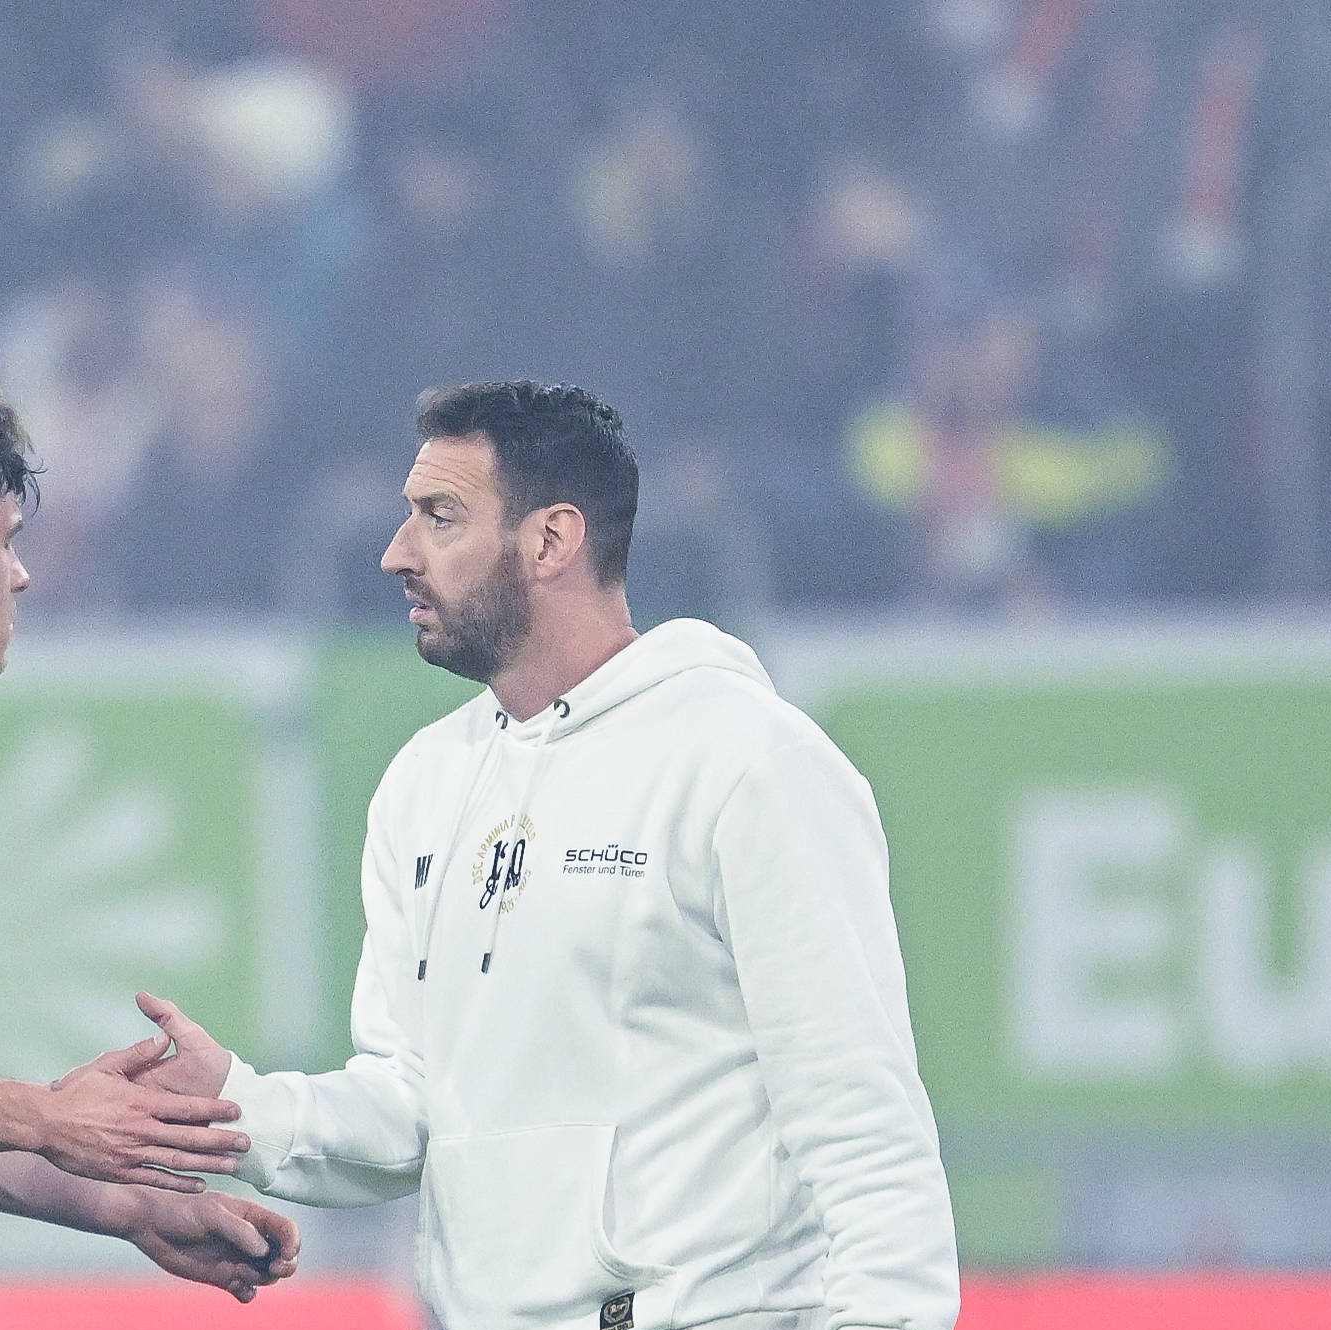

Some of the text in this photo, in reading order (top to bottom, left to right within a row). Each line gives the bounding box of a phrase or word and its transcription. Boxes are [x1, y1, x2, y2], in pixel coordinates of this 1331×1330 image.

[564, 844, 648, 866] SCHÜCO
[562, 864, 645, 879] Fenster und Türen
